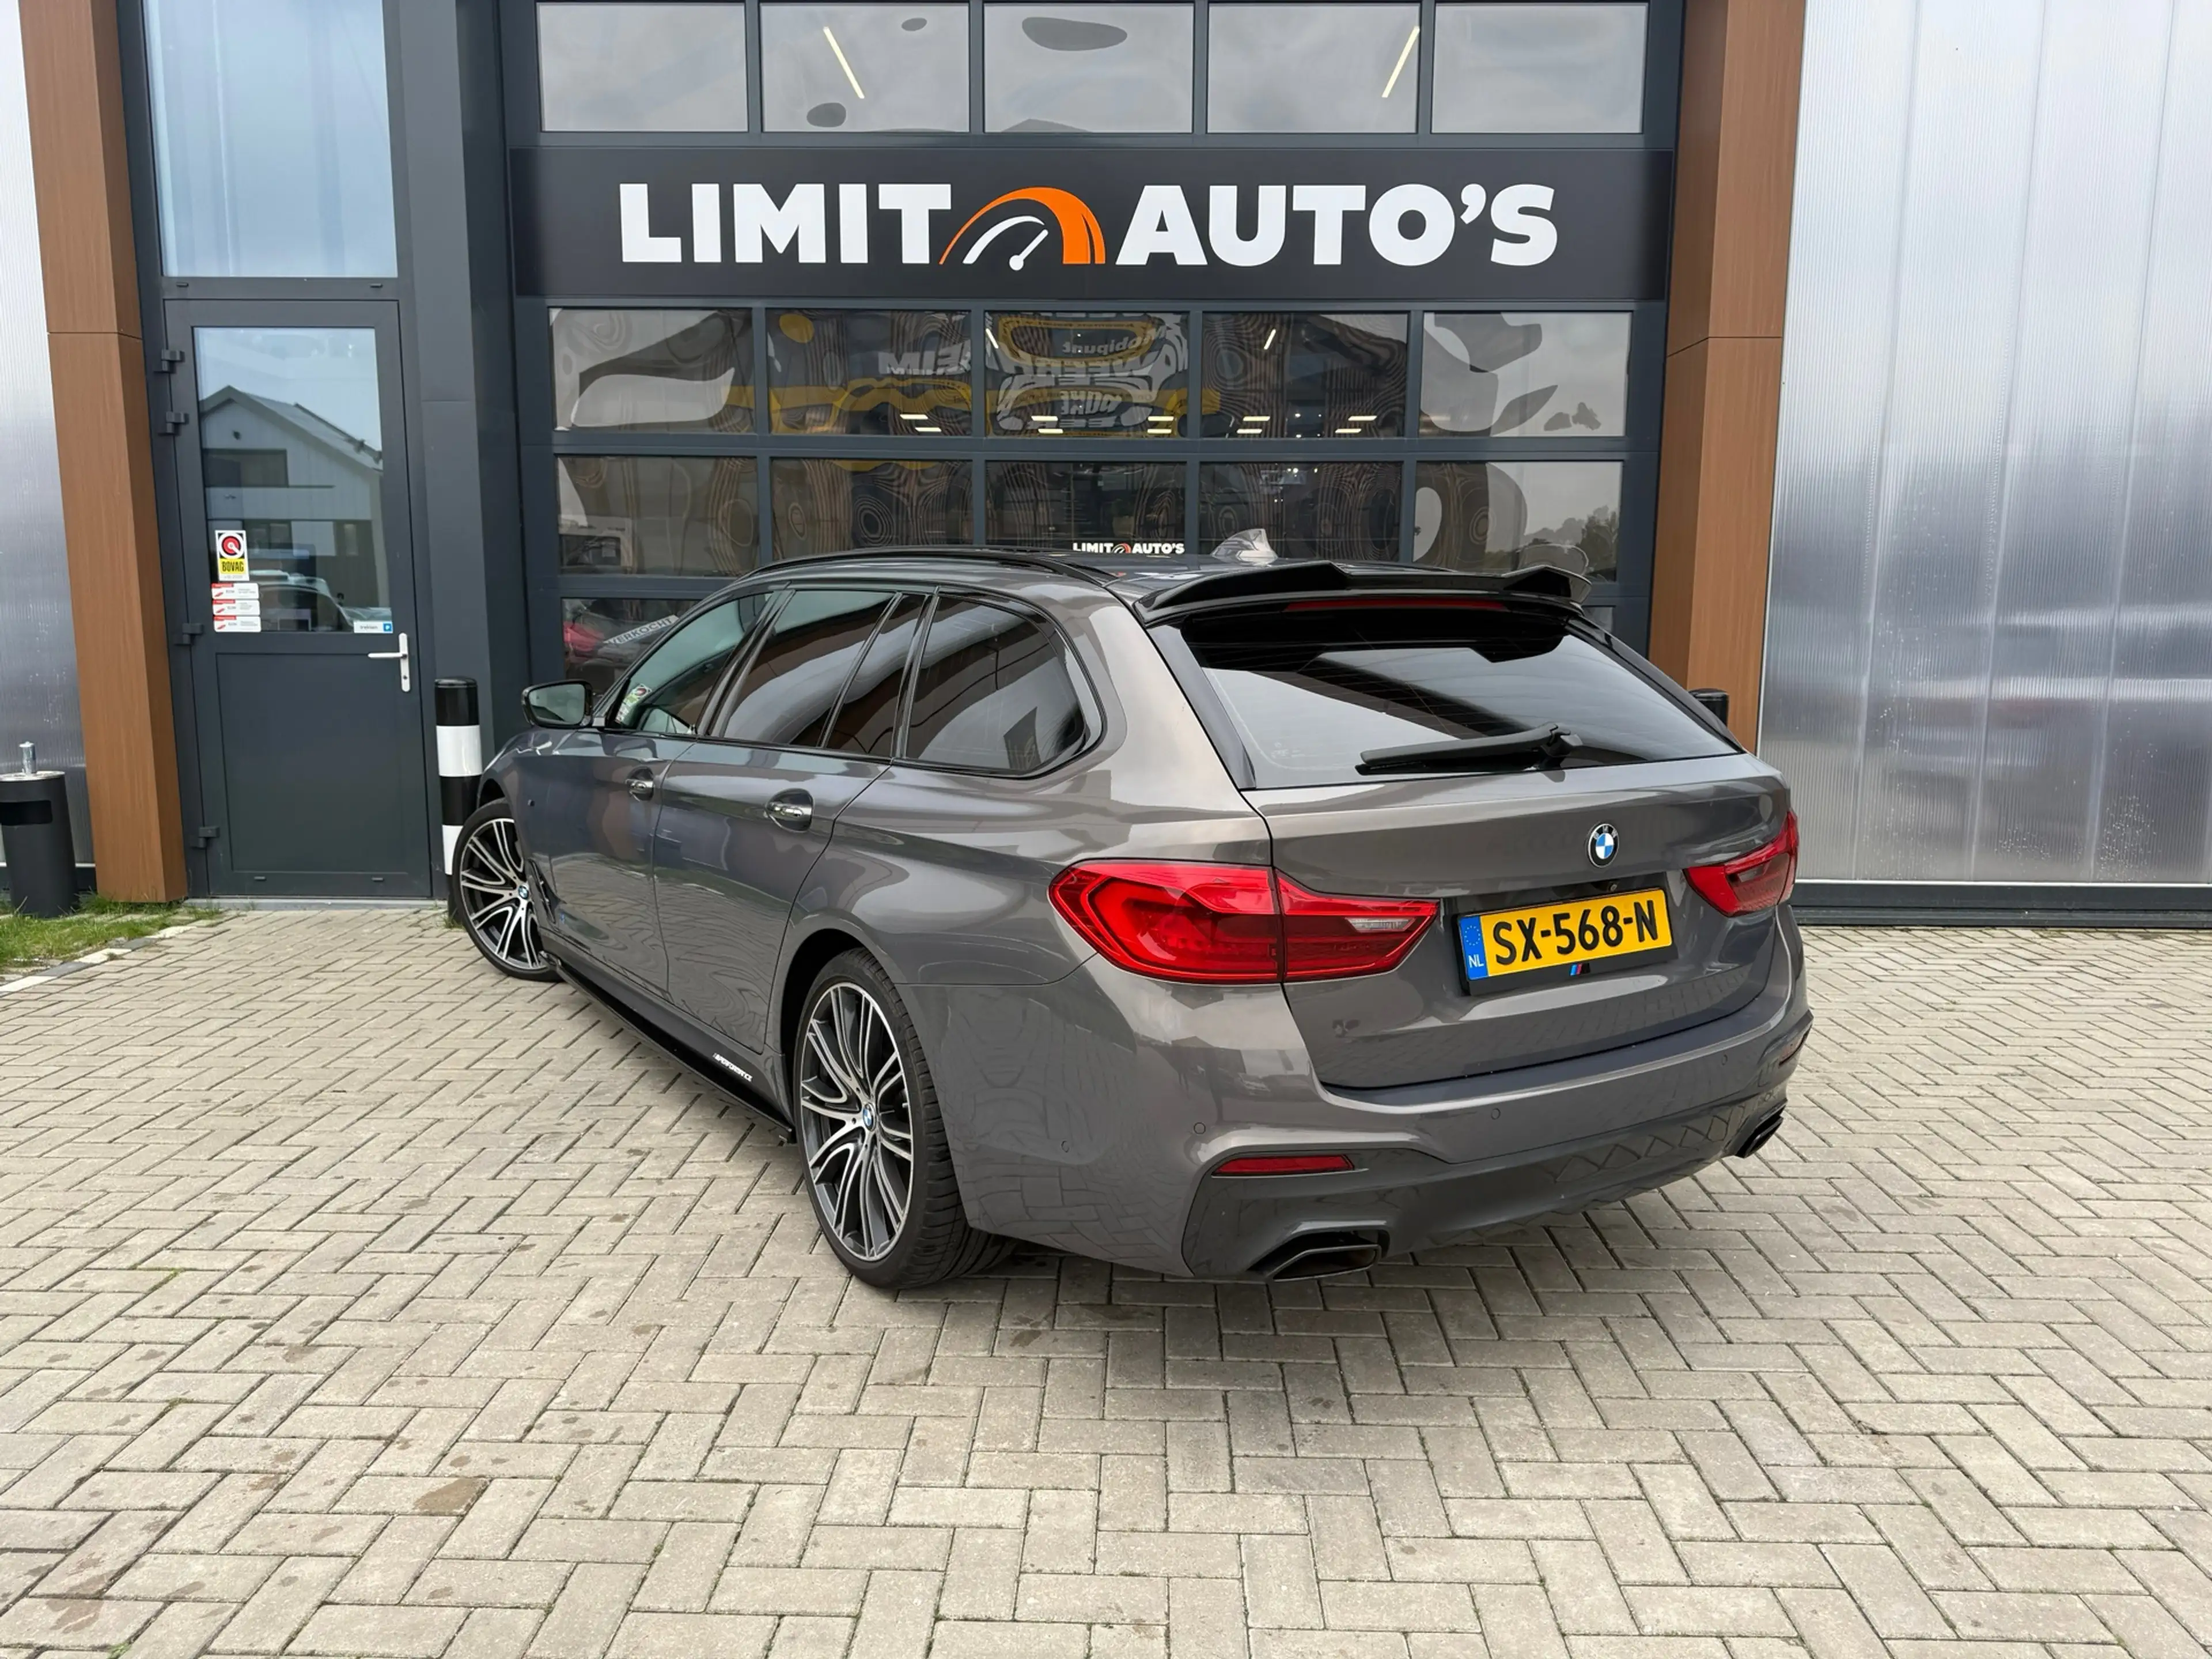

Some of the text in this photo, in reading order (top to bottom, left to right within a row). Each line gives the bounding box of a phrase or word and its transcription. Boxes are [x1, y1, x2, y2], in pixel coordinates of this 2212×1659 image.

[620, 183, 1558, 267] LIMIT AUTO'S
[1073, 543, 1185, 554] LIMIT AUTO'S
[222, 561, 244, 572] BOVAG
[1493, 900, 1658, 965] SX-568-N
[1468, 953, 1484, 968] NL
